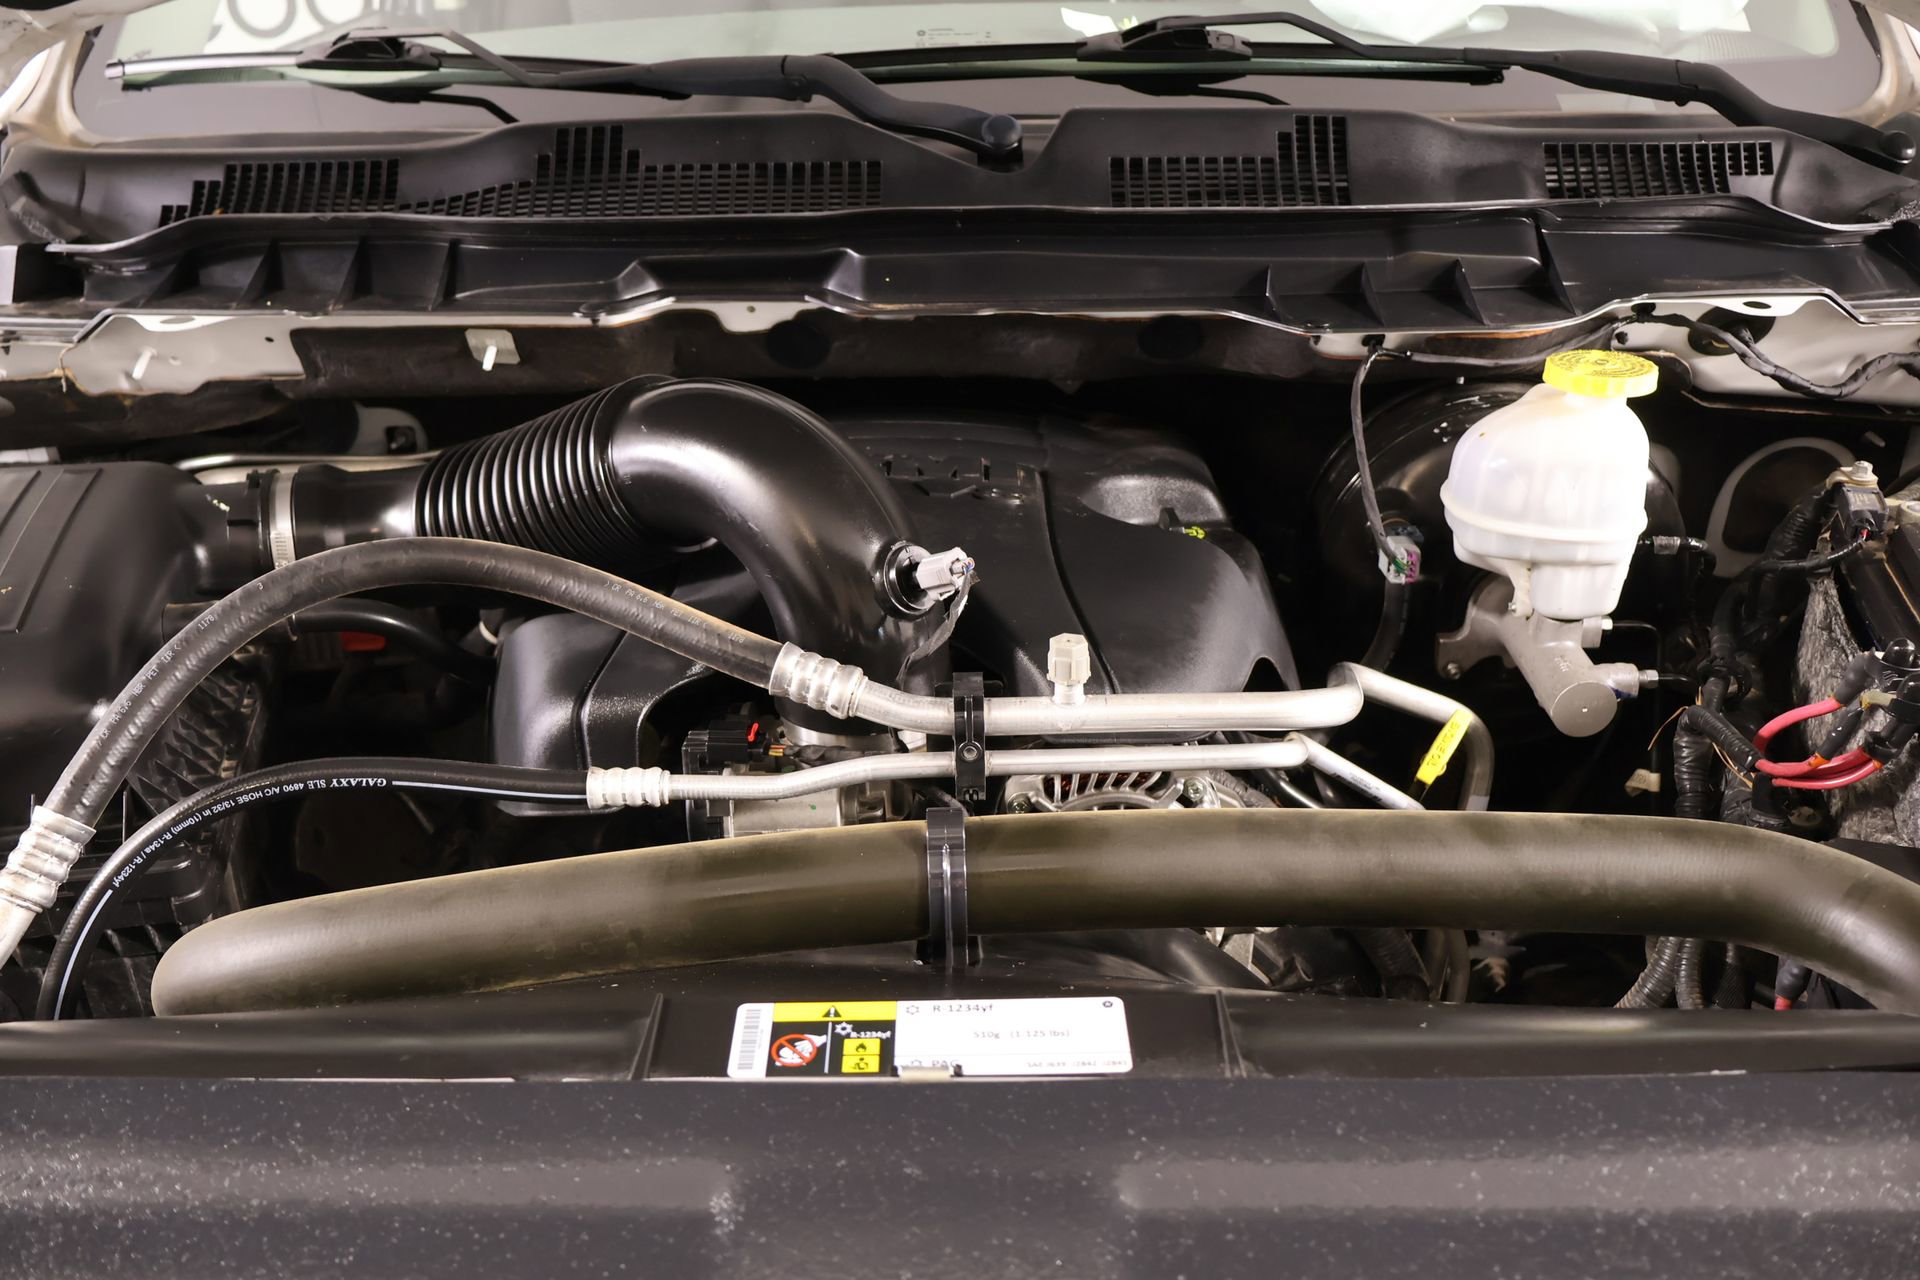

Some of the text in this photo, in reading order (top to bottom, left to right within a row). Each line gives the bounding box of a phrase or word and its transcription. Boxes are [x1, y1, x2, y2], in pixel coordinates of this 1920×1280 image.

[198, 614, 216, 630] 1178
[145, 665, 160, 680] PET
[283, 783, 304, 793] 4890
[307, 779, 327, 789] SLE
[330, 778, 386, 787] GALAXY
[236, 790, 263, 805] HOSE
[264, 786, 280, 796] A/C
[202, 808, 212, 817] in
[212, 800, 235, 814] 13/32
[171, 812, 202, 835] (10mm)
[143, 831, 173, 854] R-134a
